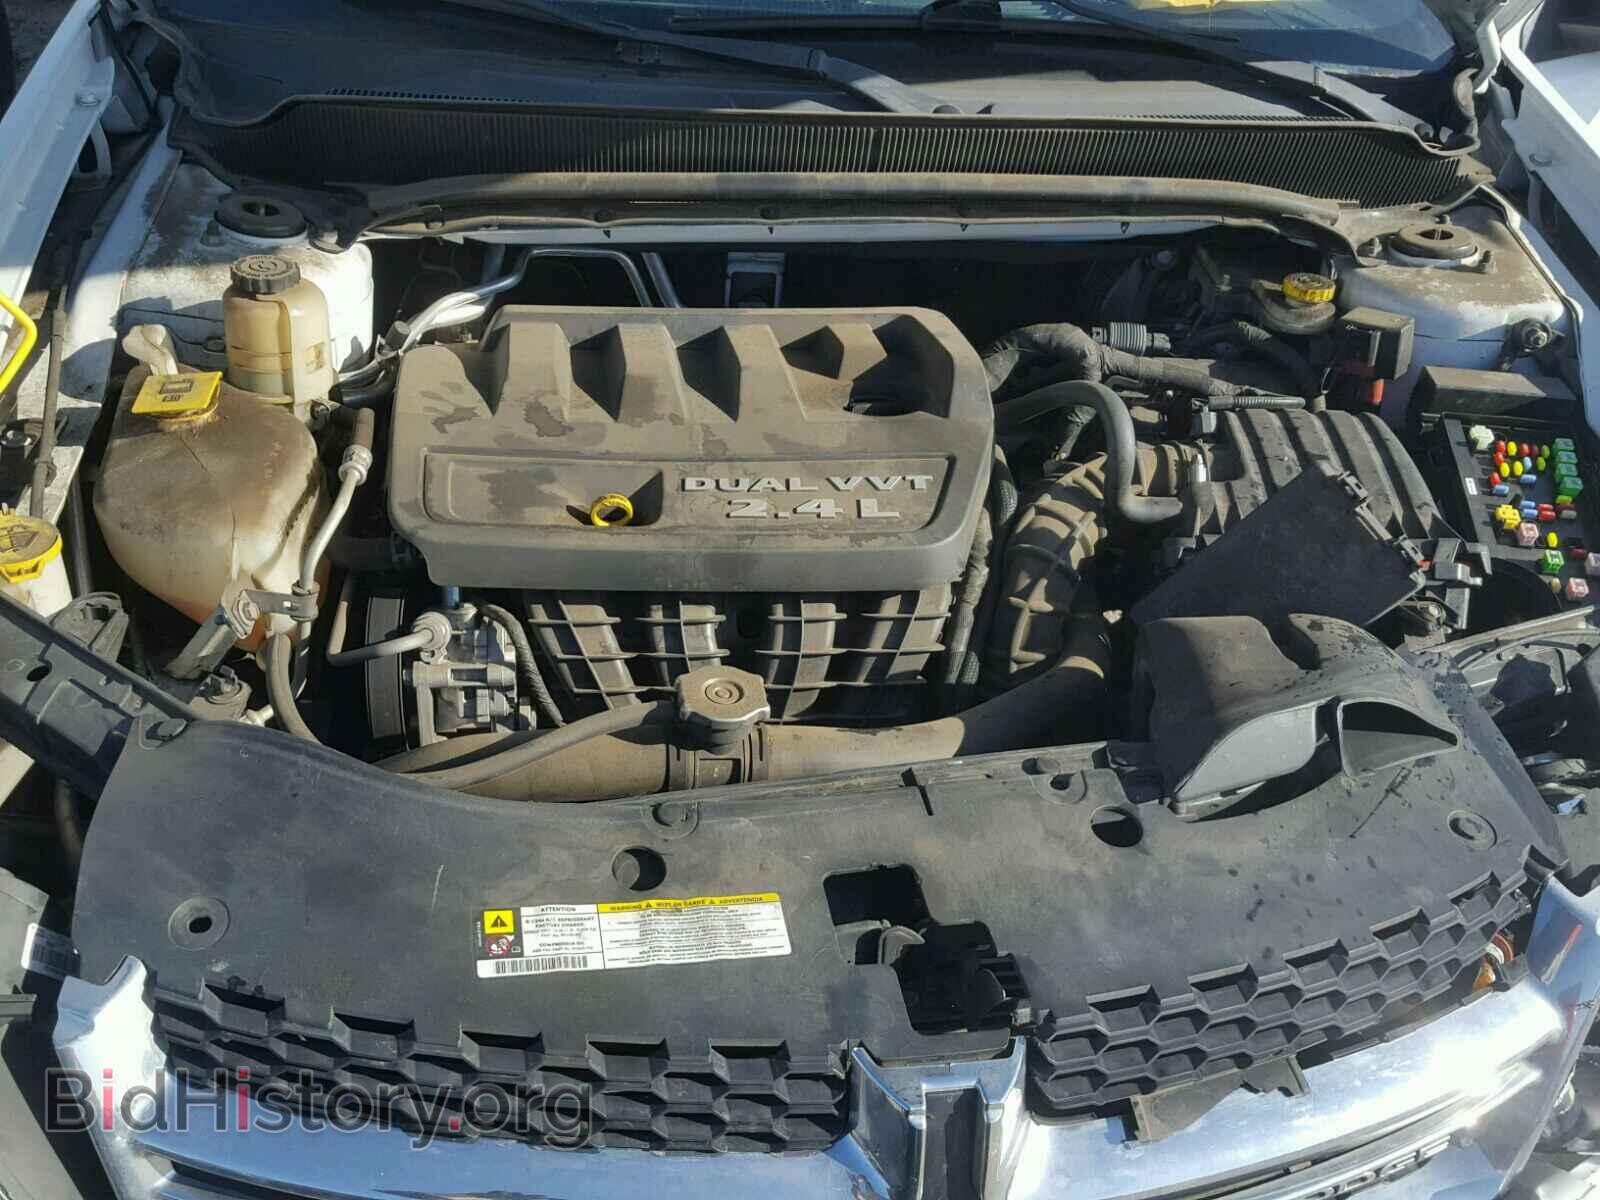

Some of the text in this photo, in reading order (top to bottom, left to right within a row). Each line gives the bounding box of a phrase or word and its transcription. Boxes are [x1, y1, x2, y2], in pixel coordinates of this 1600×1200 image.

[682, 475, 933, 493] DUAL VVT
[1302, 1135, 1451, 1200] ODGE
